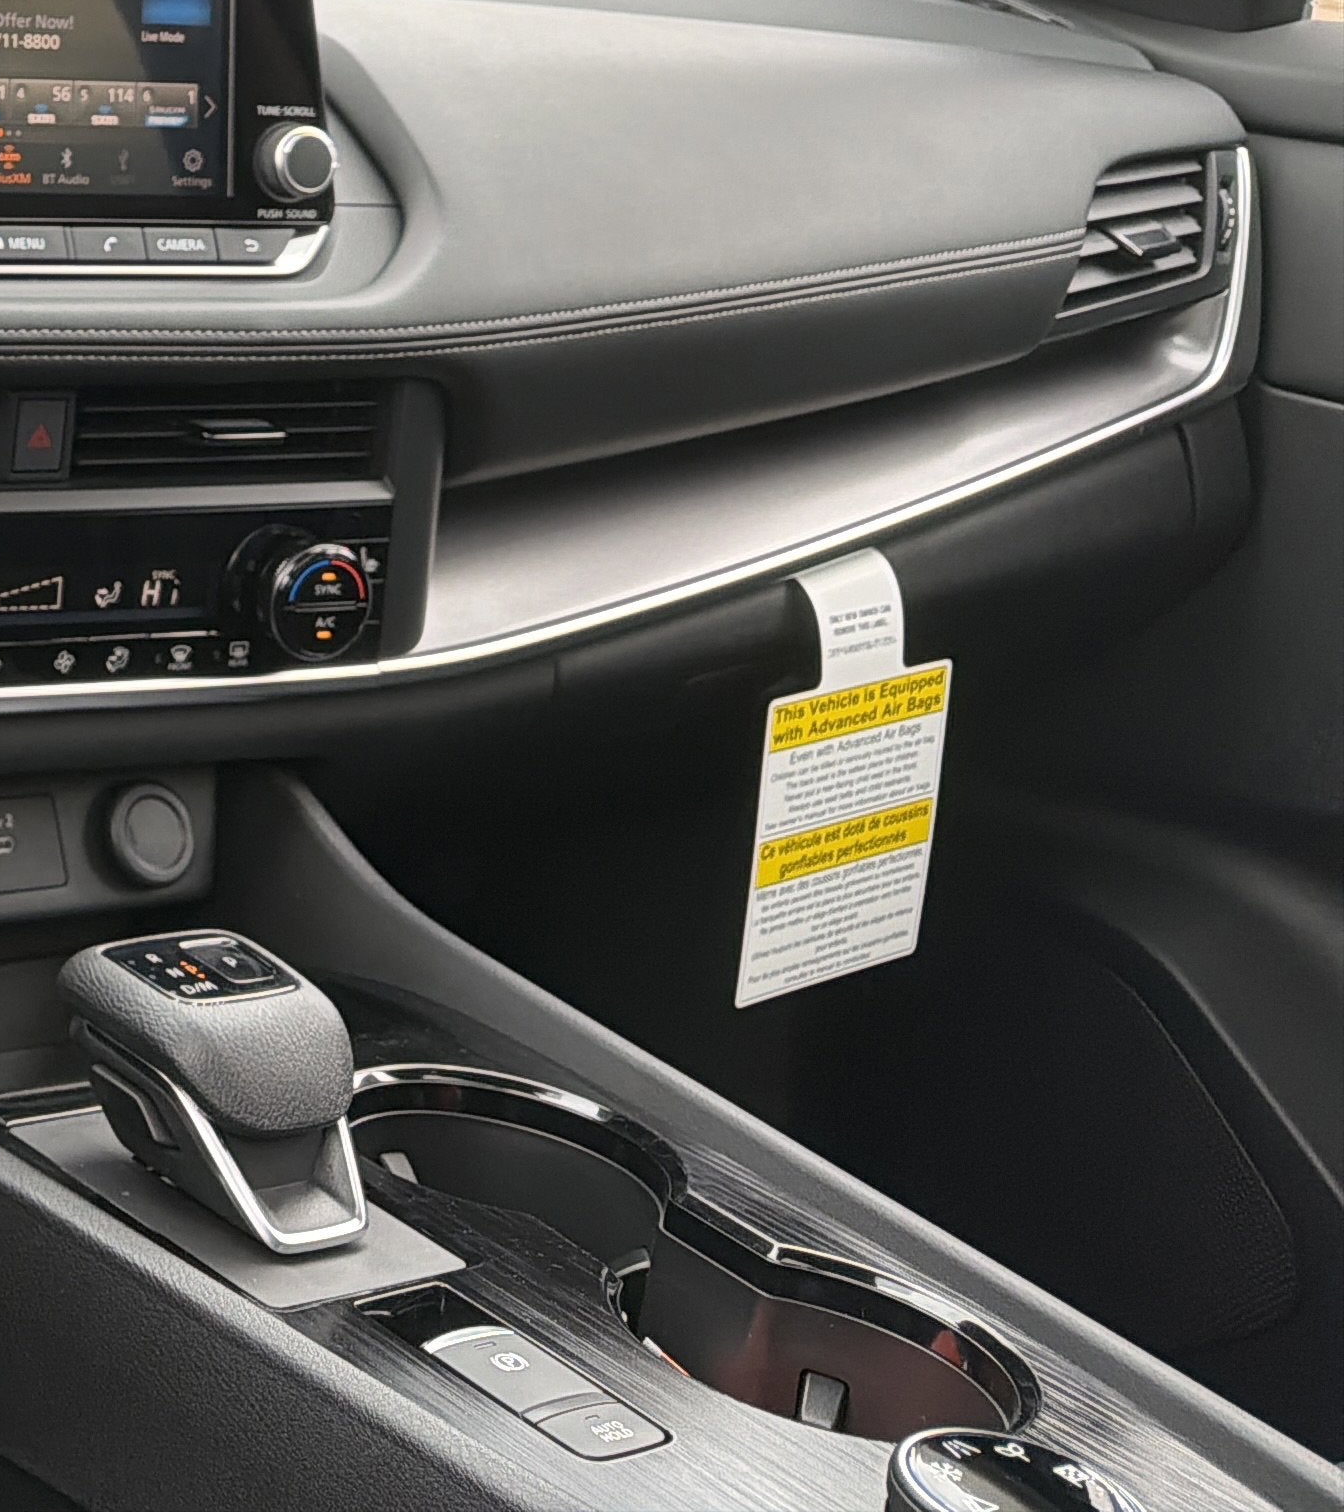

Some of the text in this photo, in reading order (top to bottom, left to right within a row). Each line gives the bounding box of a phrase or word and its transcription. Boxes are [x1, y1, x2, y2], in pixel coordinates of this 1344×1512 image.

[35, 14, 74, 30] Now!
[141, 31, 184, 43] Live Mode
[16, 87, 25, 99] 4
[52, 86, 71, 101] 56
[80, 89, 88, 100] 5
[108, 88, 134, 102] 114
[143, 90, 151, 102] 6
[188, 90, 196, 104] 1
[42, 173, 89, 185] BT Audio
[172, 176, 212, 189] Settings
[257, 208, 317, 219] PUSH SOUND
[8, 237, 46, 250] MENU
[157, 238, 205, 252] CAMERA
[314, 584, 342, 595] SYNC
[315, 616, 336, 628] A/C
[775, 705, 805, 724] This
[810, 693, 859, 713] Vehicle
[880, 671, 944, 701] Equipped
[773, 693, 941, 745] with Advanced Air Bags
[145, 953, 163, 963] R
[222, 957, 237, 968] P
[180, 981, 218, 995] D/M
[590, 1421, 624, 1435] AUTO
[600, 1428, 634, 1443] HOLD
